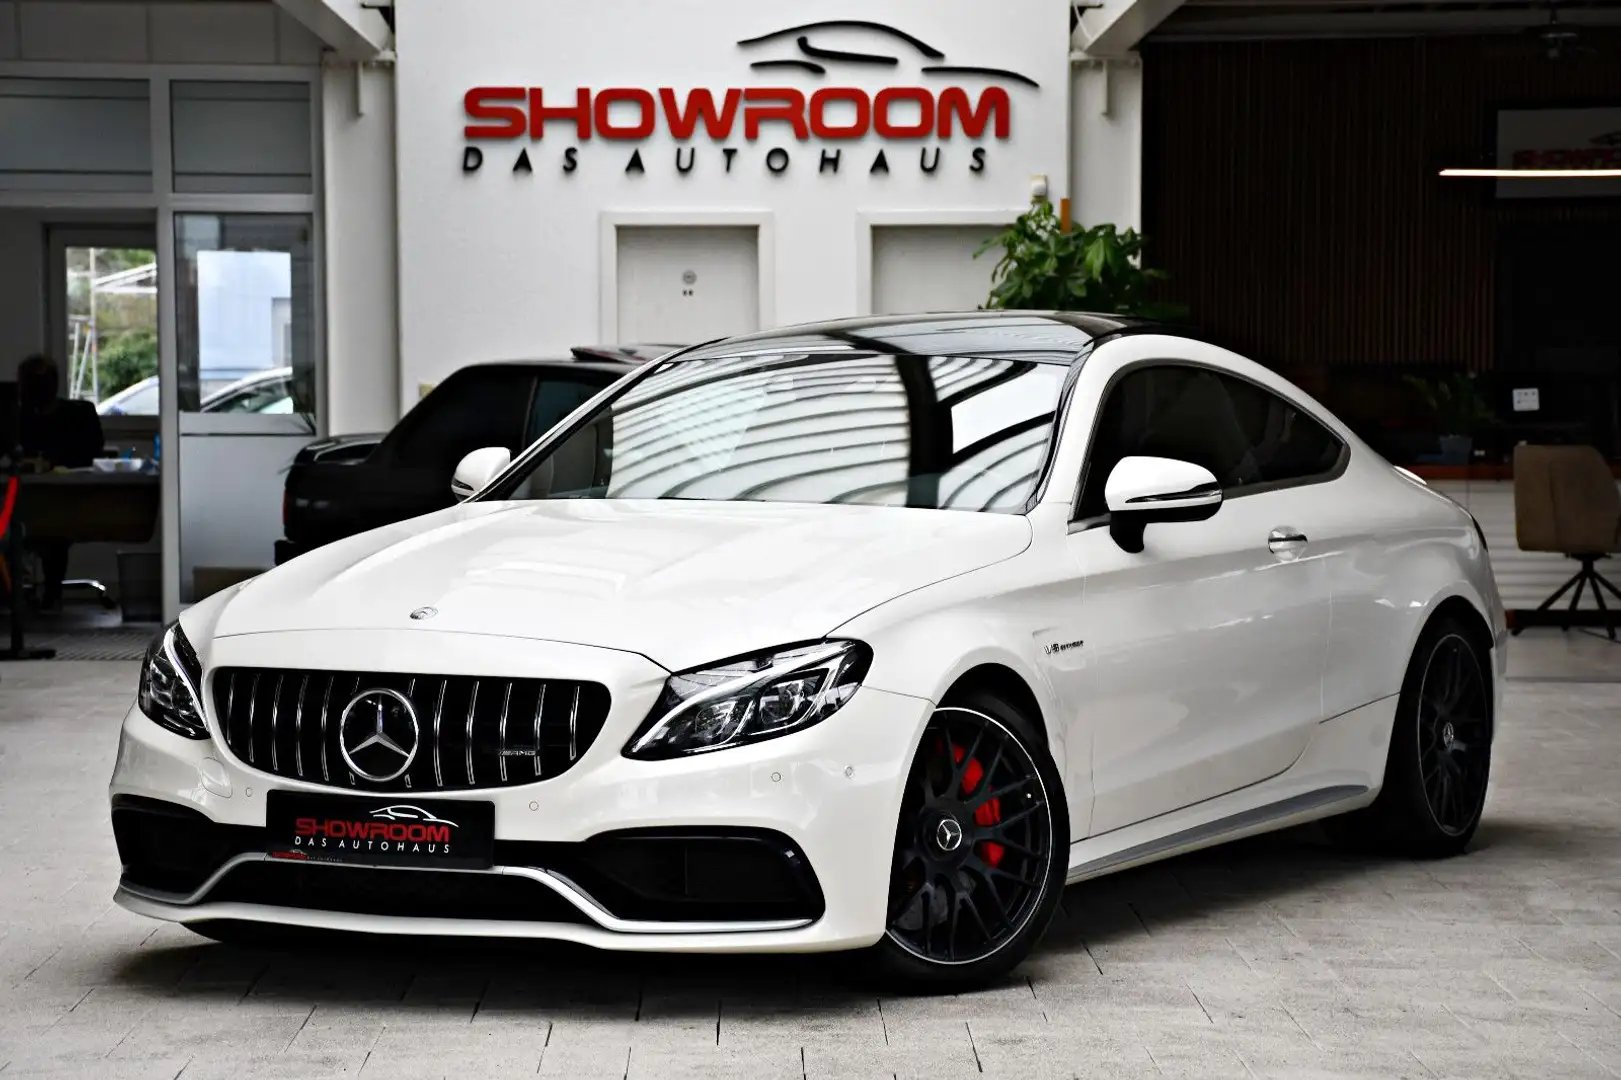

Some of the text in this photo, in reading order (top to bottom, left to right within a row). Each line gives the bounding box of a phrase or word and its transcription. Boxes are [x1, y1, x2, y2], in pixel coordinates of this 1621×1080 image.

[464, 86, 1010, 140] SHOWROOM
[462, 146, 987, 174] DAS AUTOHAUS
[296, 818, 450, 842] SHOWROOM
[294, 835, 450, 854] DAS AUTOHAUS
